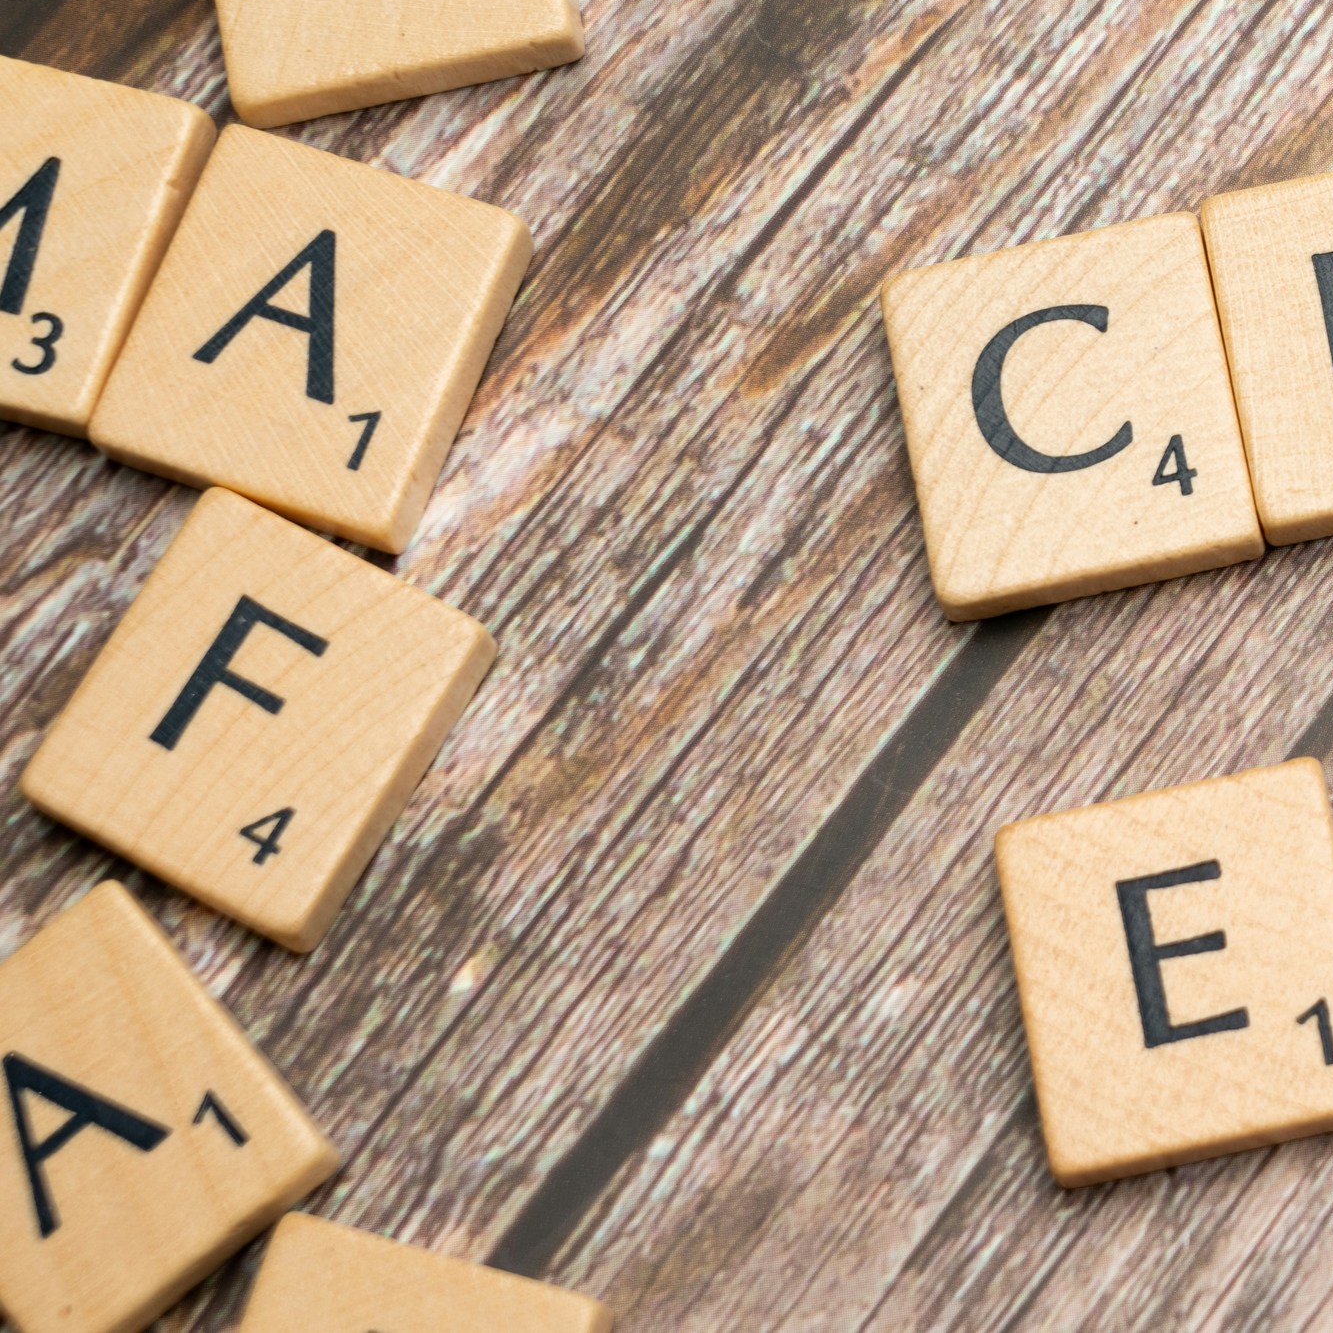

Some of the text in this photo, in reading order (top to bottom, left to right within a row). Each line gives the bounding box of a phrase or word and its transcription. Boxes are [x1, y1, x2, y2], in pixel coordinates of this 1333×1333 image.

[11, 312, 63, 375] 3
[192, 229, 381, 471] A 1
[1152, 434, 1197, 496] 4
[148, 594, 329, 865] F 4
[1115, 859, 1250, 1049] E
[1, 1052, 249, 1239] A 1
